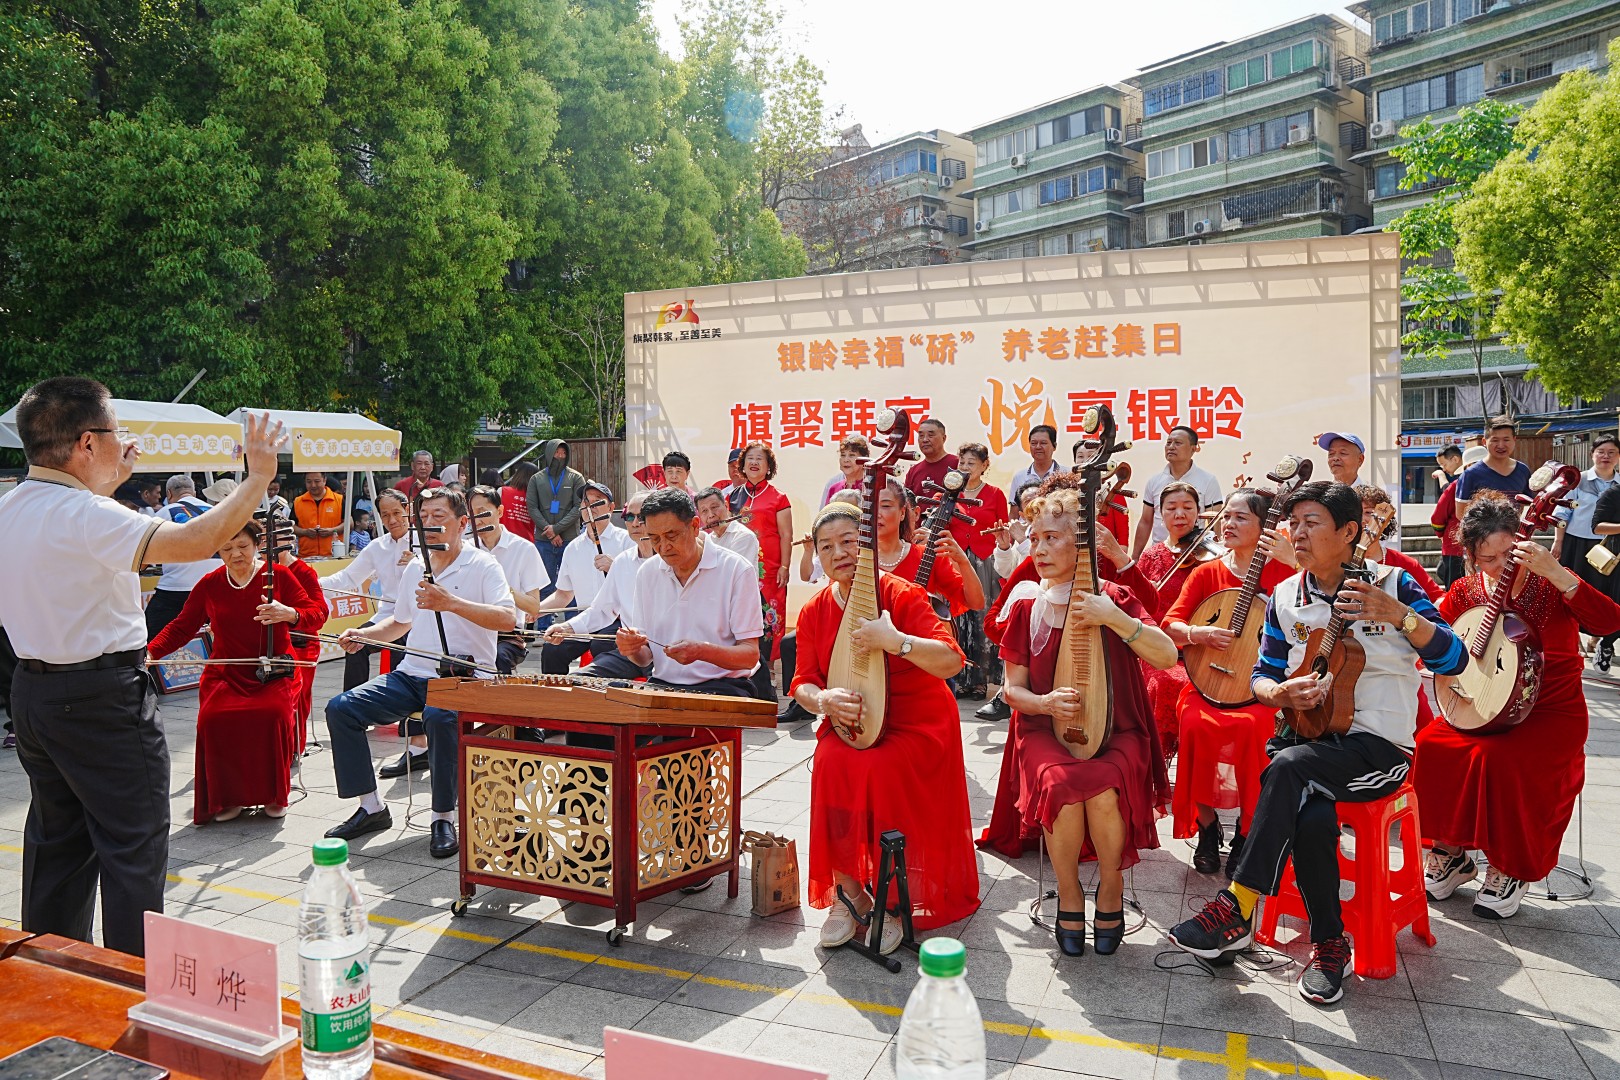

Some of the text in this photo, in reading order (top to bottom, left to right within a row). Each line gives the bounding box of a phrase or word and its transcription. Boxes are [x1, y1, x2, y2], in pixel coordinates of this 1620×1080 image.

[1001, 323, 1183, 362] 养老赶集日
[129, 436, 233, 452] 硚口互动空间
[303, 441, 393, 454] 书香硚口互动空间
[336, 597, 364, 617] 展示
